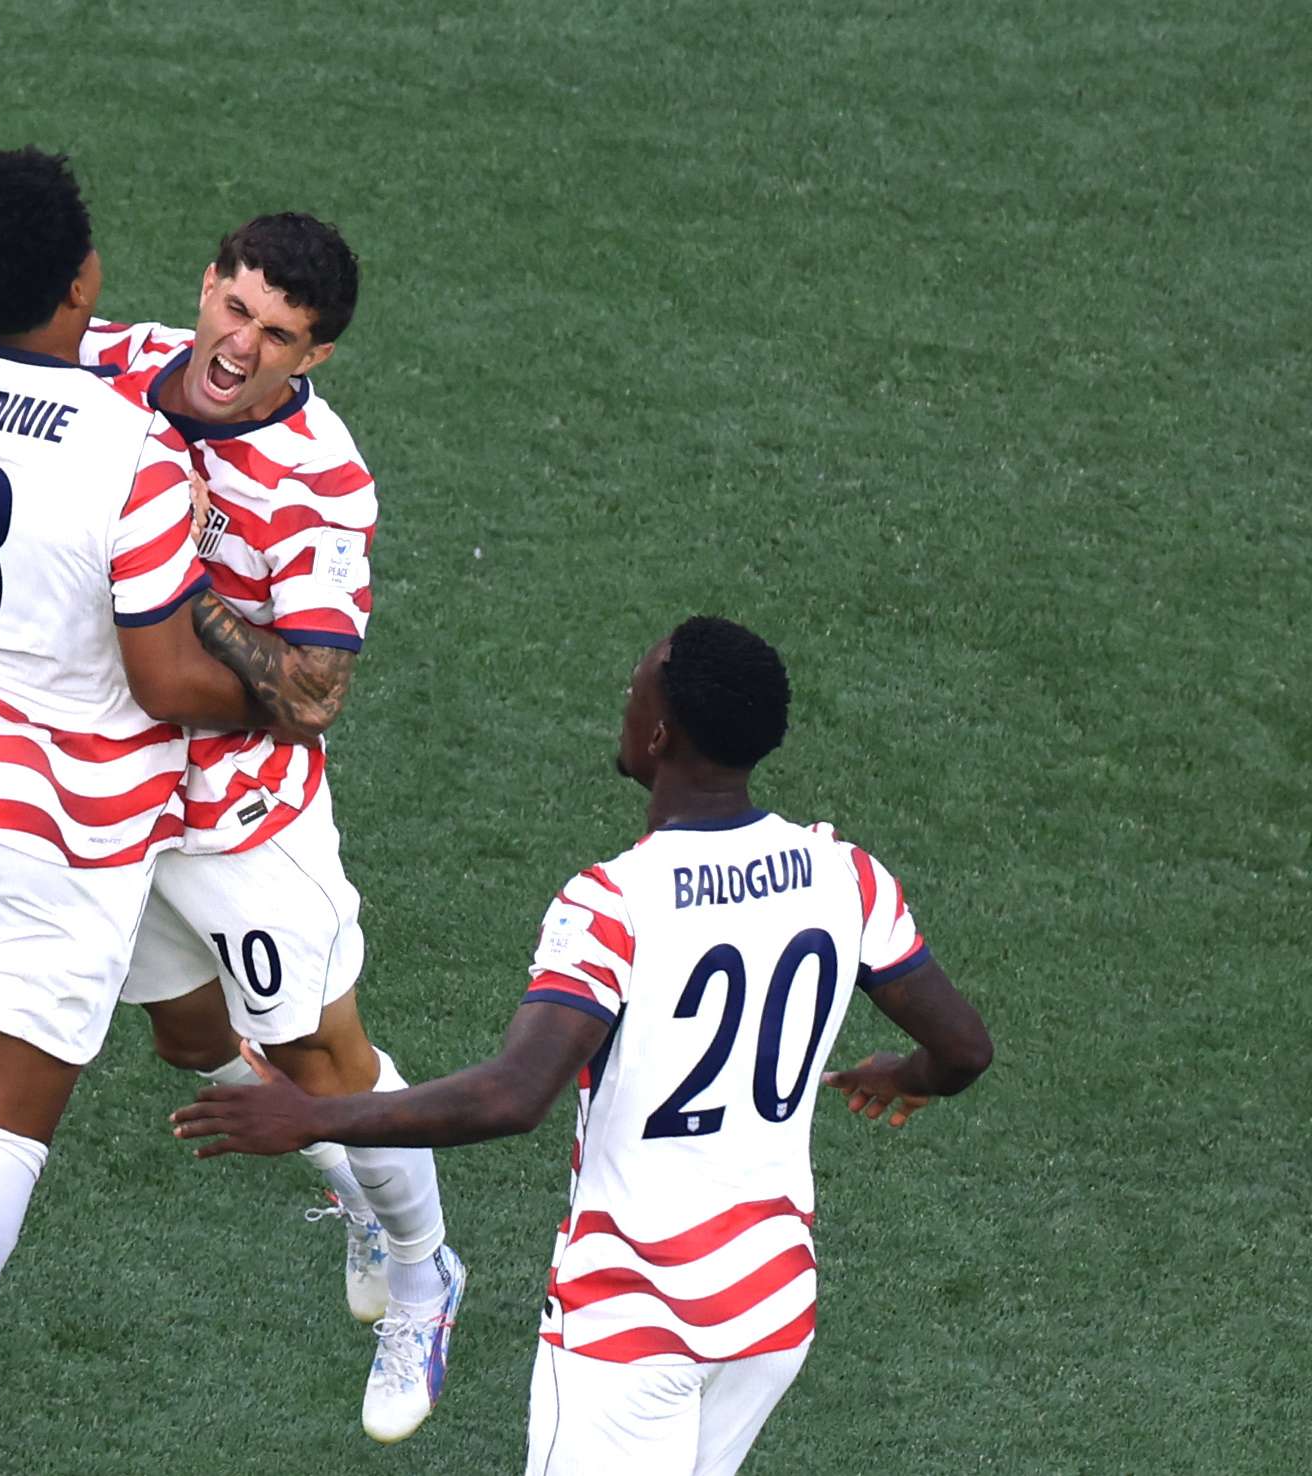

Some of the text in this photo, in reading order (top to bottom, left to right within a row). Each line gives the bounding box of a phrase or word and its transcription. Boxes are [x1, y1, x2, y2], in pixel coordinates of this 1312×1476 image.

[673, 847, 812, 909] BALOGUN
[209, 929, 282, 997] 10
[641, 927, 838, 1140] 20
